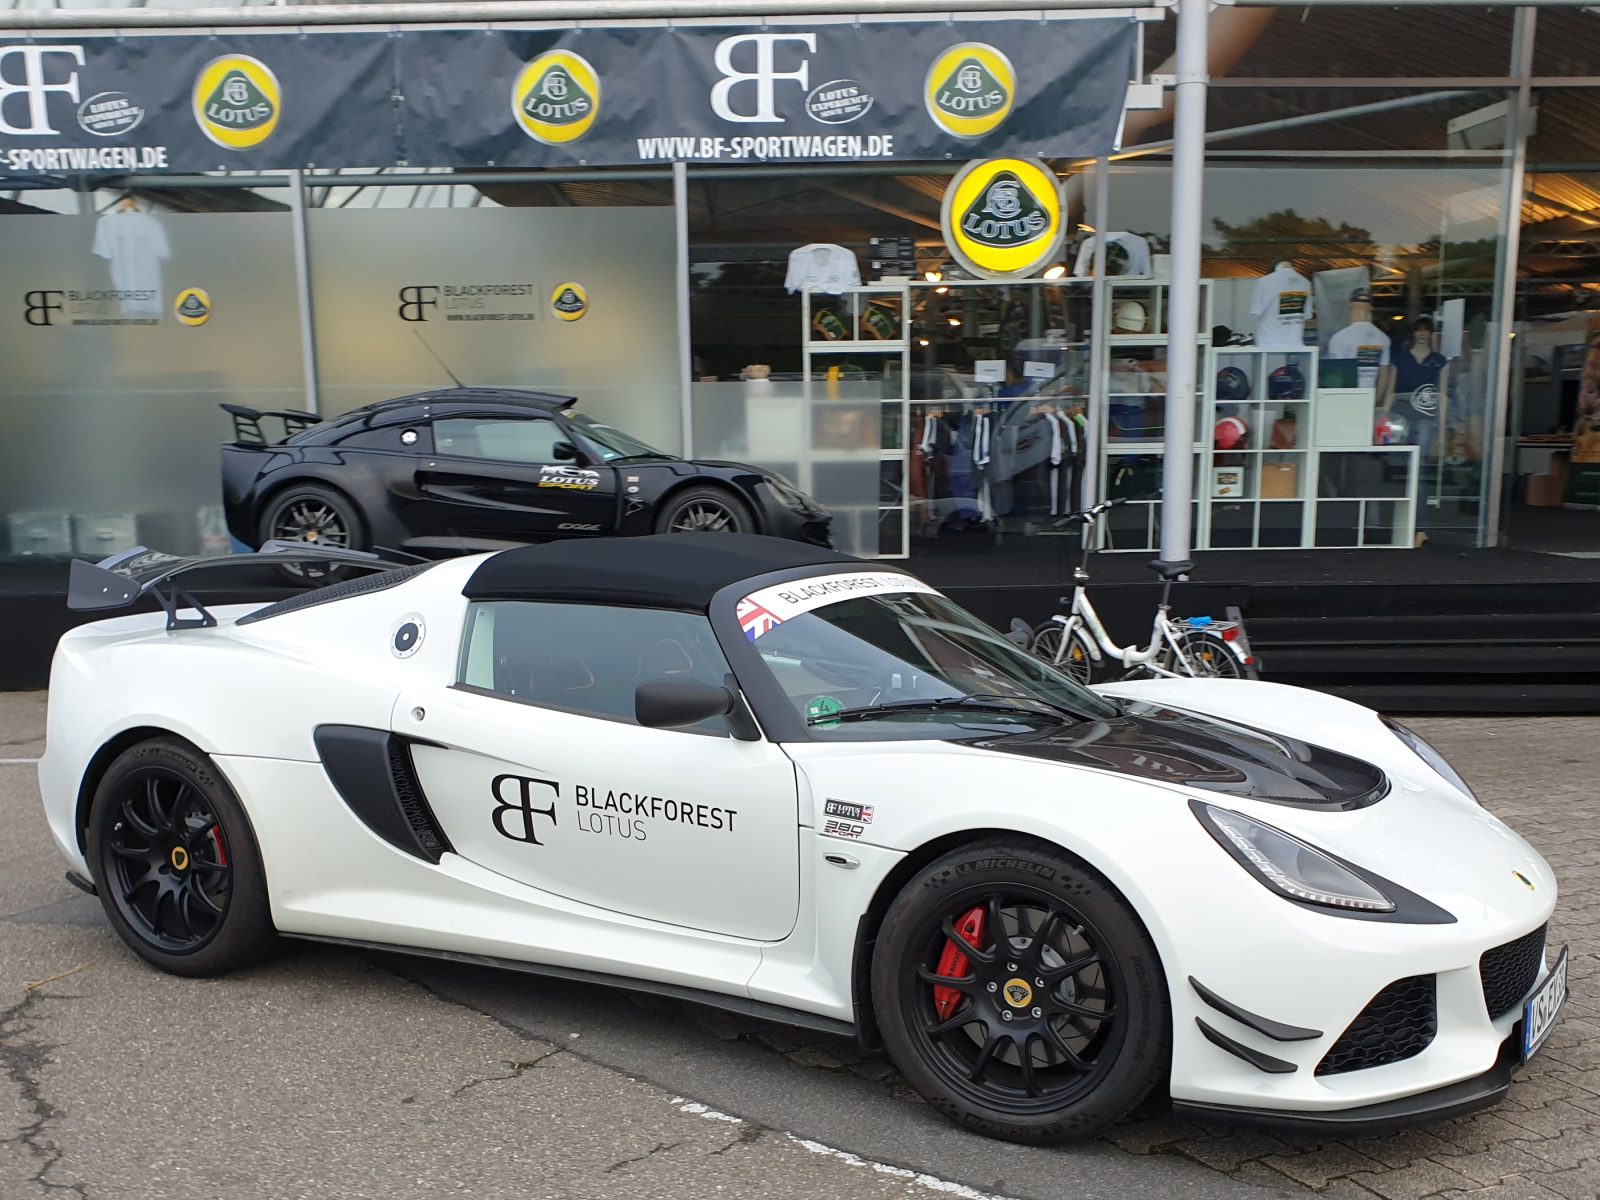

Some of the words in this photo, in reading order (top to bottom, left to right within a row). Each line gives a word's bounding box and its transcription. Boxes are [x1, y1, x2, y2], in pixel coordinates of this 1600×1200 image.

[525, 98, 588, 118] LOTUS
[939, 90, 1003, 110] LOTUS
[207, 103, 270, 122] LOTUS
[637, 135, 893, 160] WWW.BF-SPORTWAGEN.DE
[0, 147, 168, 170] -SPORTWAGEN.DE
[963, 211, 1046, 238] LOTUS
[444, 285, 533, 296] BLACKFOREST
[540, 476, 599, 485] LOTUS
[777, 577, 884, 604] BLACKFOREST
[575, 785, 737, 832] BLACKFOREST
[838, 804, 860, 813] LOTUS
[577, 810, 647, 841] LOTUS
[823, 828, 861, 838] SPORT
[974, 858, 1056, 879] MICHELIN
